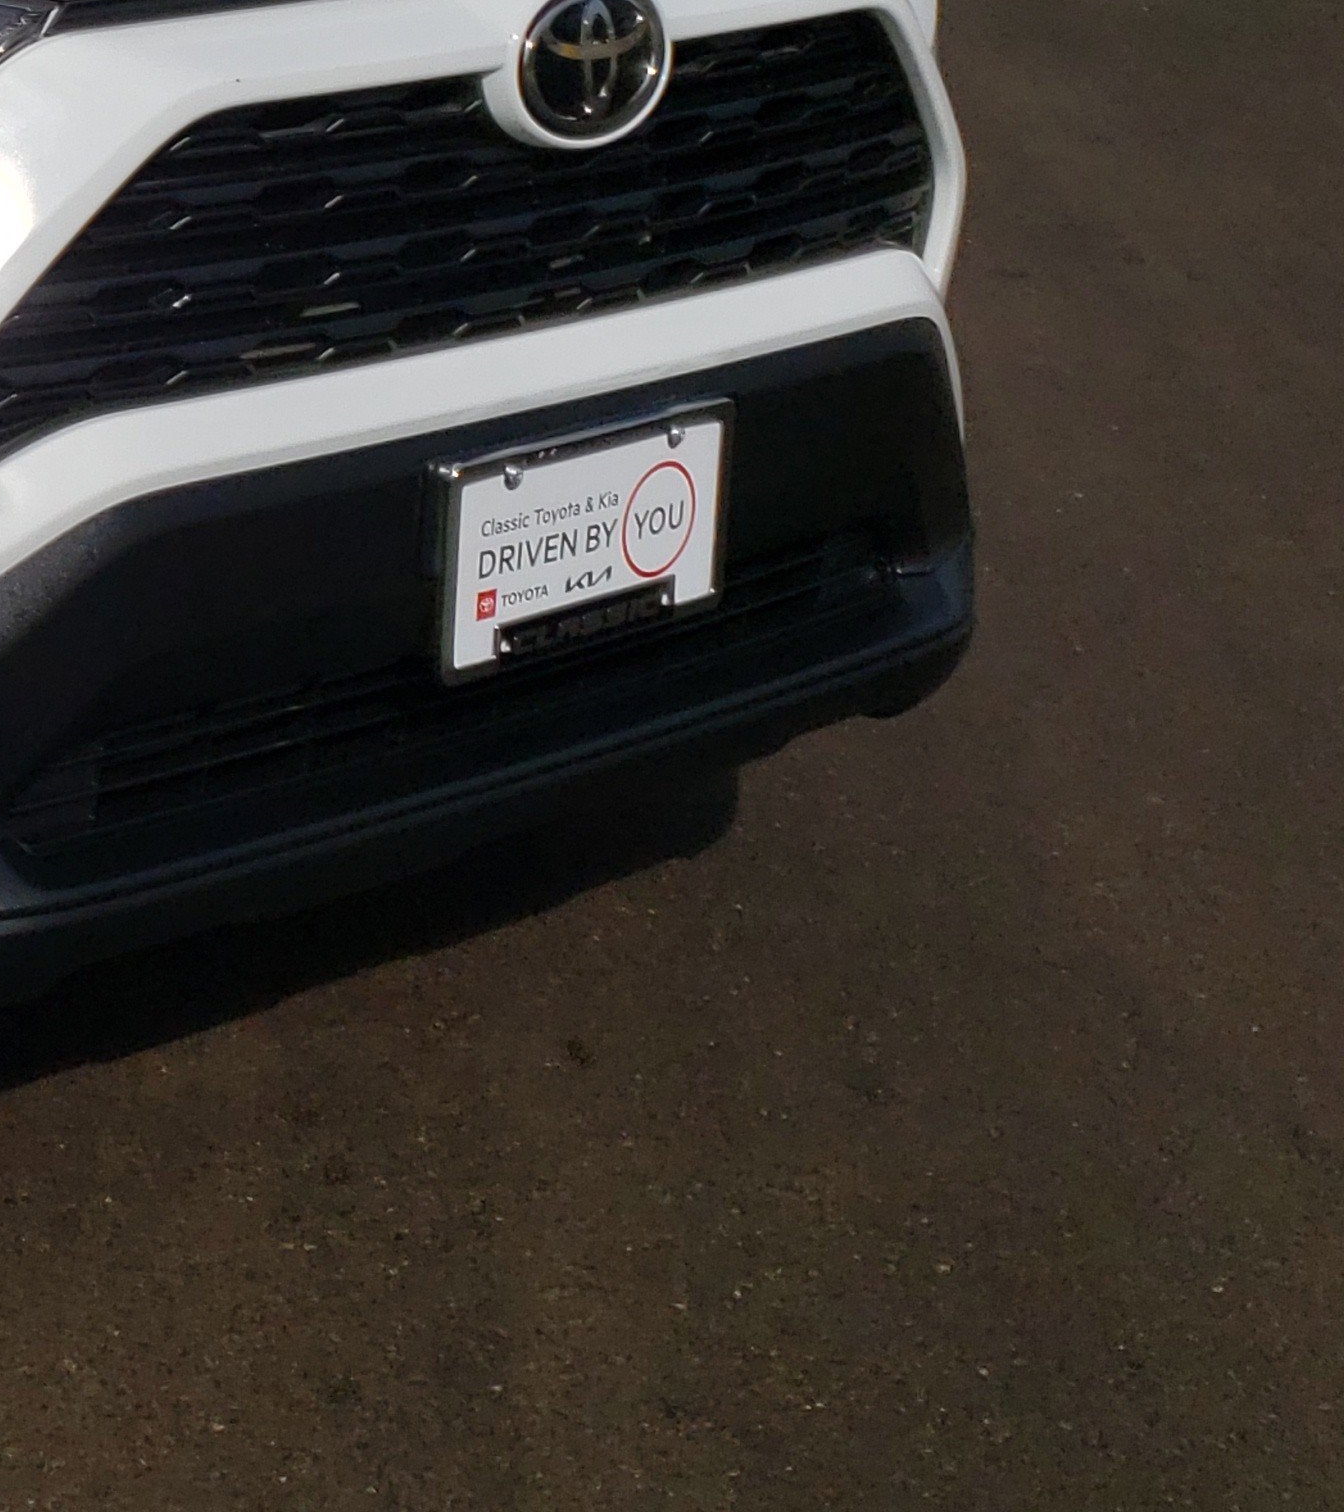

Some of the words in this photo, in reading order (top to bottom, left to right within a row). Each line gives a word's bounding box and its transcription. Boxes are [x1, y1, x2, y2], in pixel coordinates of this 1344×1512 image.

[481, 512, 530, 537] Classic
[534, 502, 581, 526] Toyota
[585, 496, 594, 513] &
[598, 491, 619, 510] Kia
[478, 529, 578, 579] DRIVEN
[585, 518, 618, 553] BY
[634, 500, 685, 540] YOU
[501, 584, 549, 607] TOYOTA
